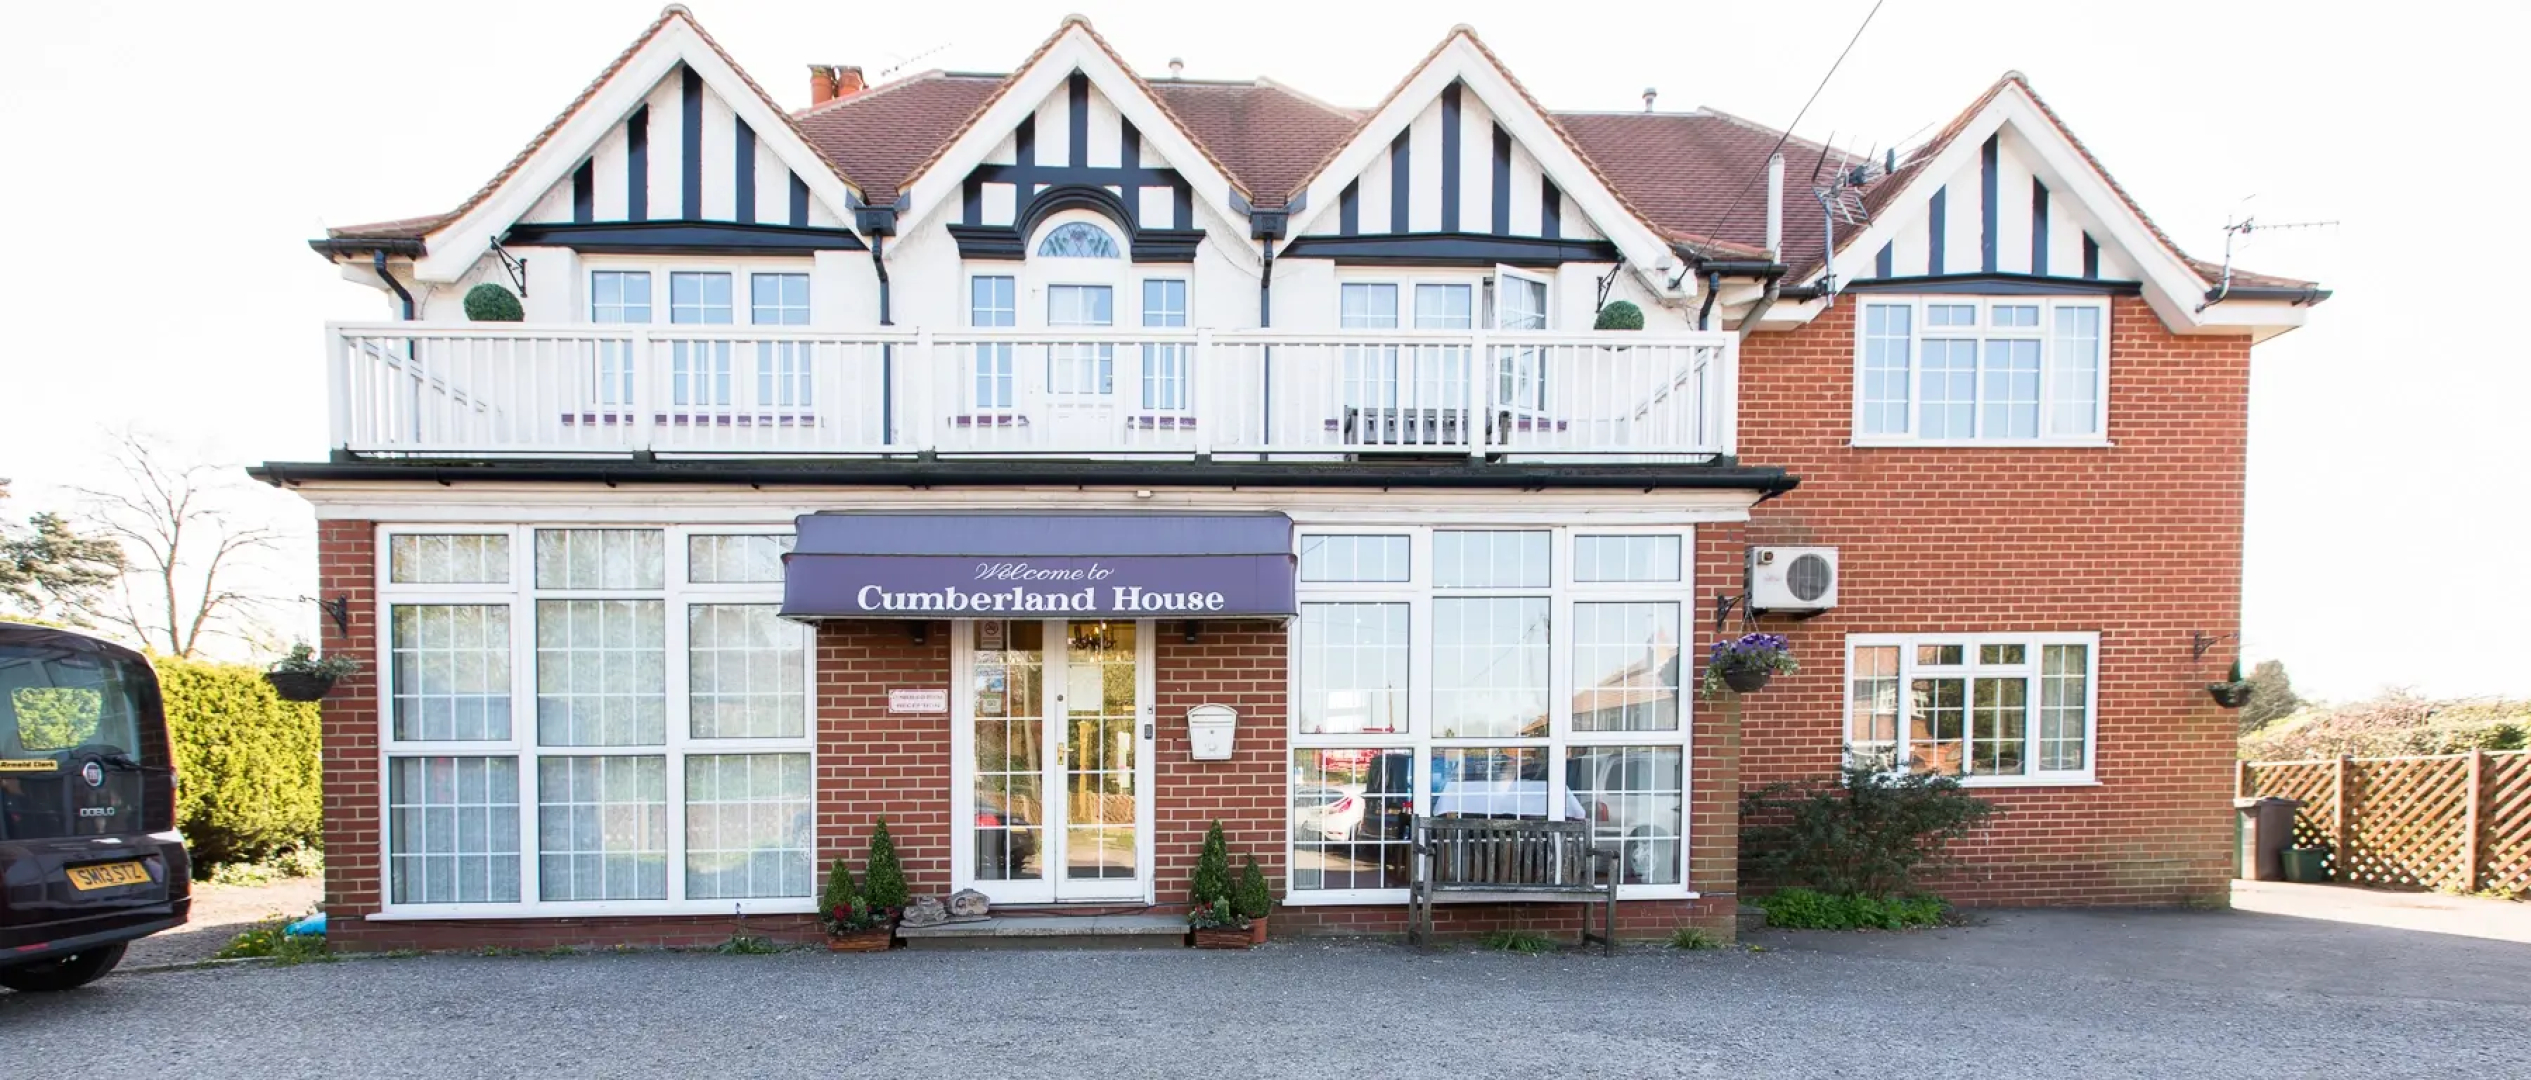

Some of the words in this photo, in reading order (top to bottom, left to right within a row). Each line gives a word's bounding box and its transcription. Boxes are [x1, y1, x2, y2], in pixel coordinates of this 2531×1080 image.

[974, 562, 1085, 580] Welcome
[1087, 562, 1115, 580] to
[857, 584, 1097, 611] Cumberland
[1112, 586, 1225, 611] House
